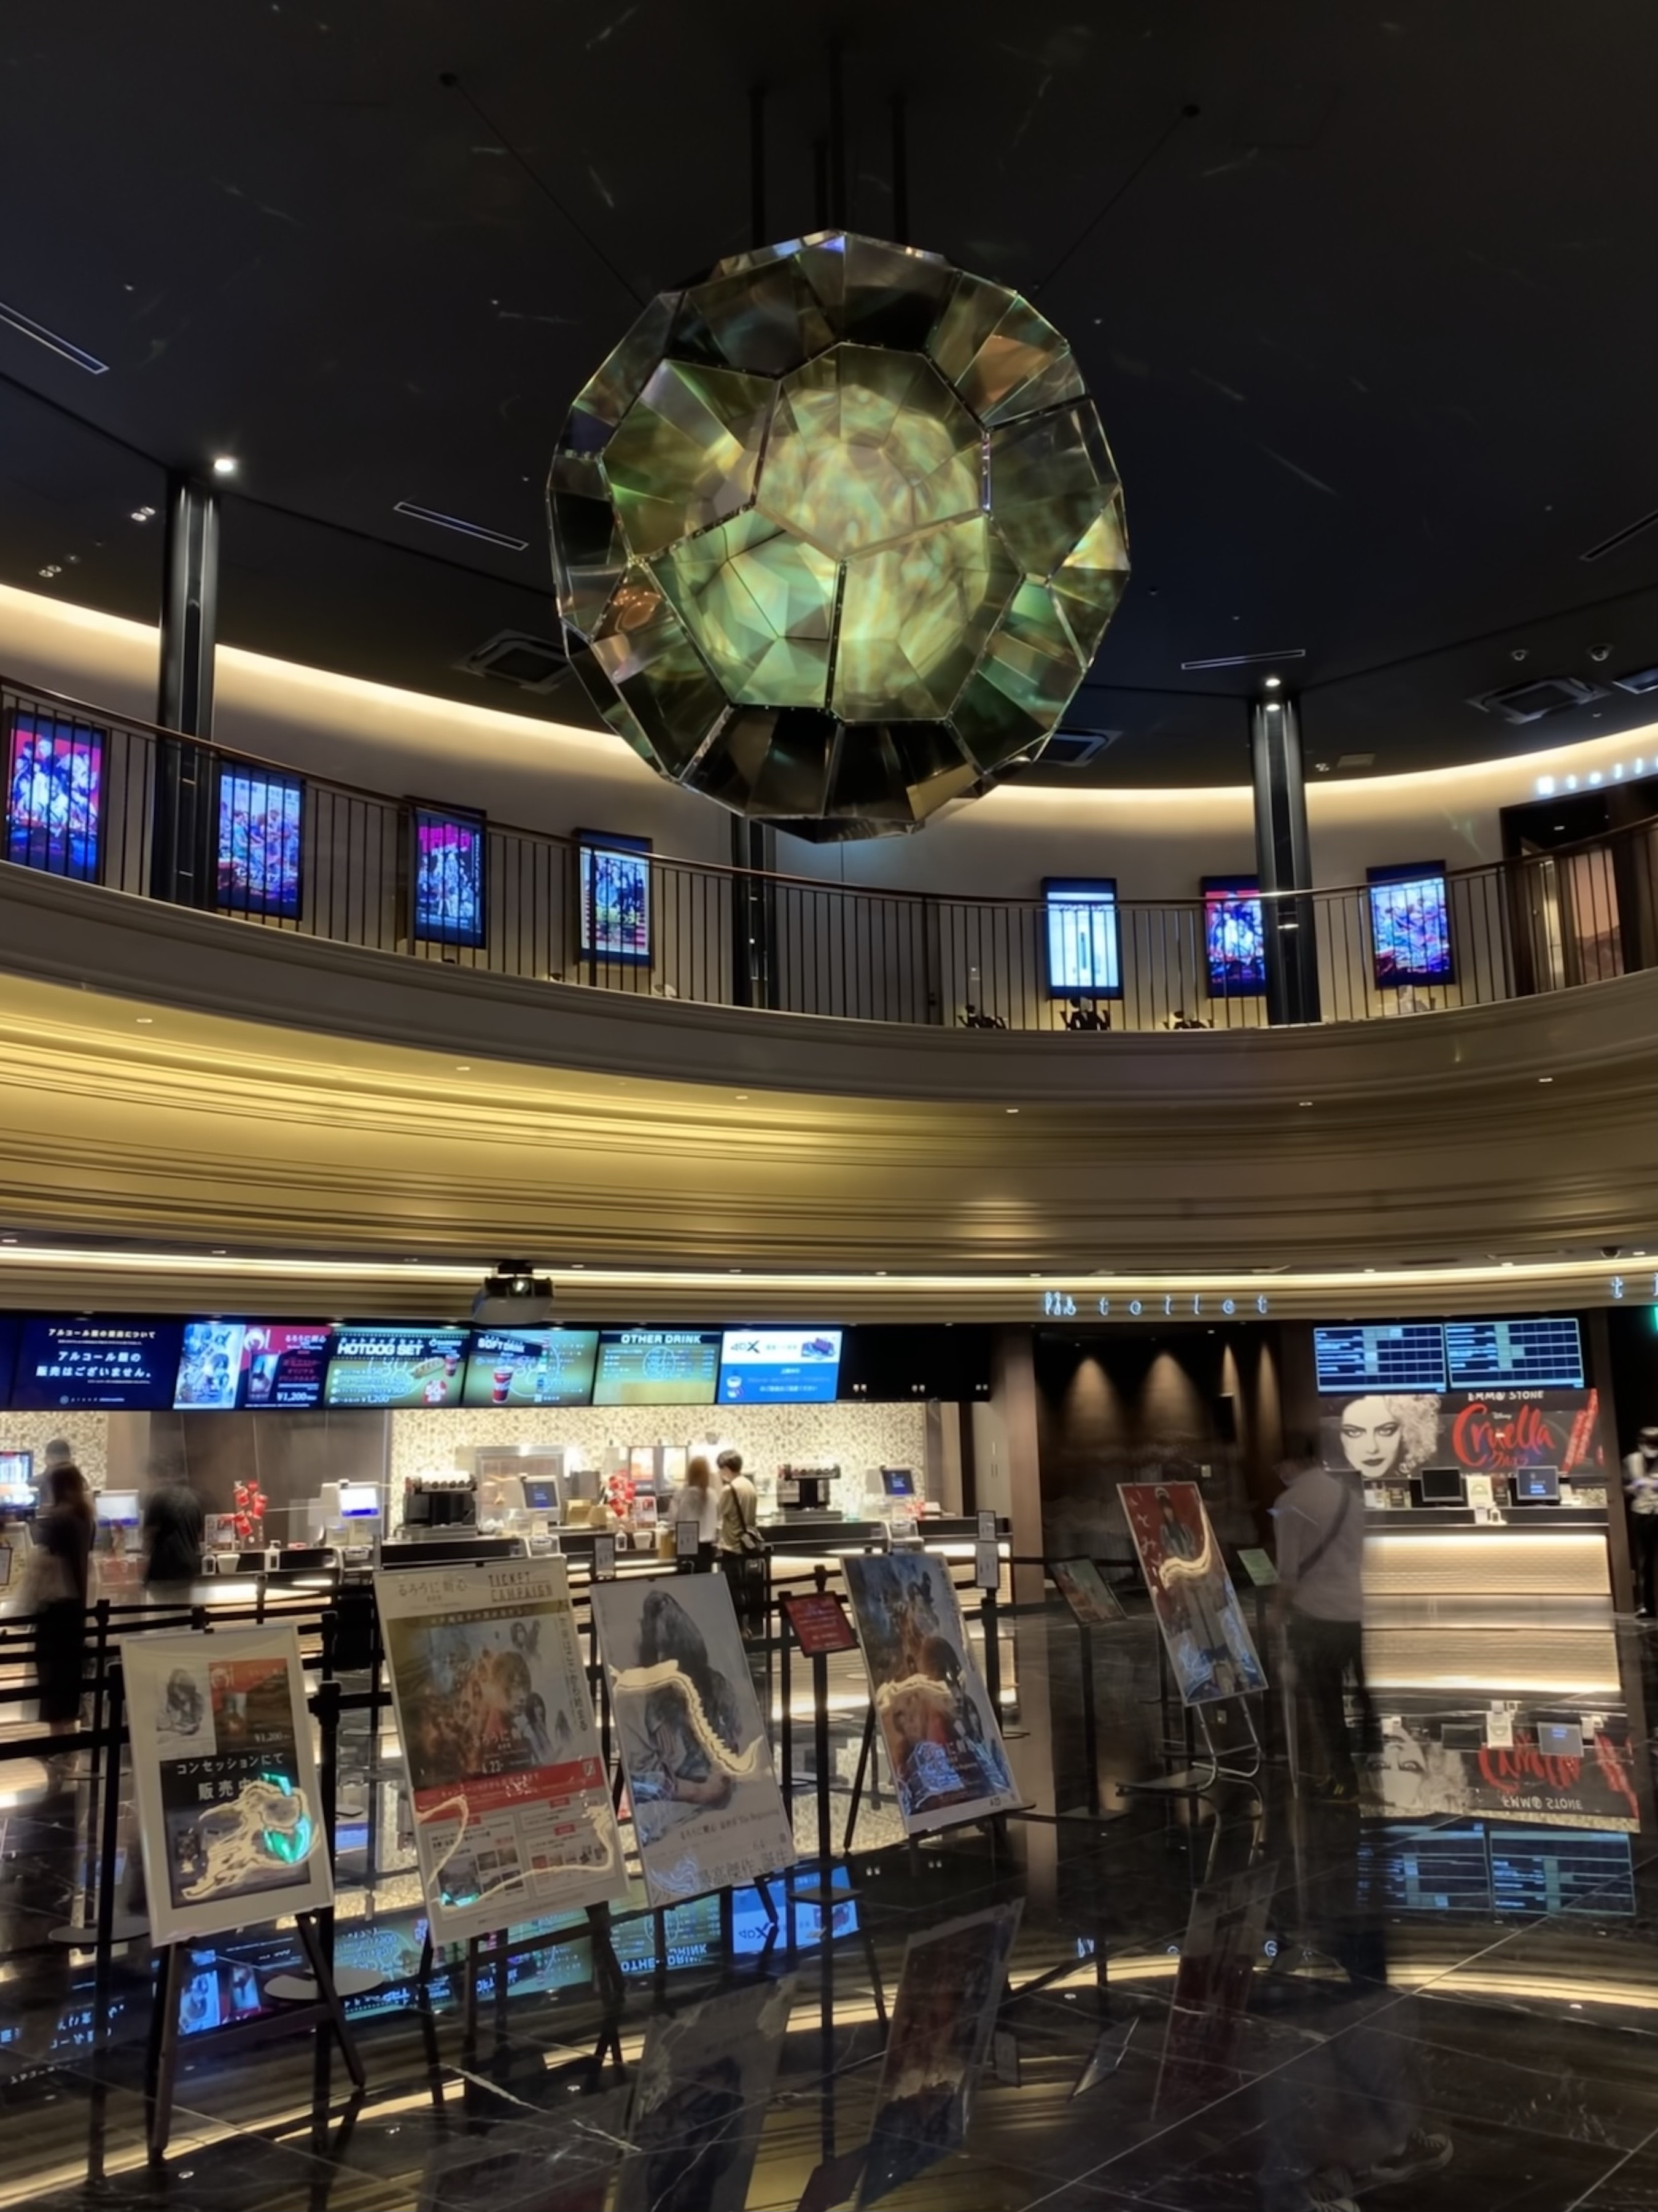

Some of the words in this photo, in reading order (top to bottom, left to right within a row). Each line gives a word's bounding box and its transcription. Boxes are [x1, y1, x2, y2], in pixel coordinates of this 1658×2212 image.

[478, 1338, 502, 1349] SOFT
[621, 1333, 662, 1344] OTHER
[664, 1334, 702, 1345] DRINK
[337, 1342, 397, 1356] HOTDOG
[397, 1343, 424, 1356] SET
[1452, 1403, 1555, 1467] Cruella
[488, 1571, 530, 1587] TICKET
[490, 1583, 553, 1602] CAMPAIGN
[176, 1753, 284, 1775] コンセッションにて
